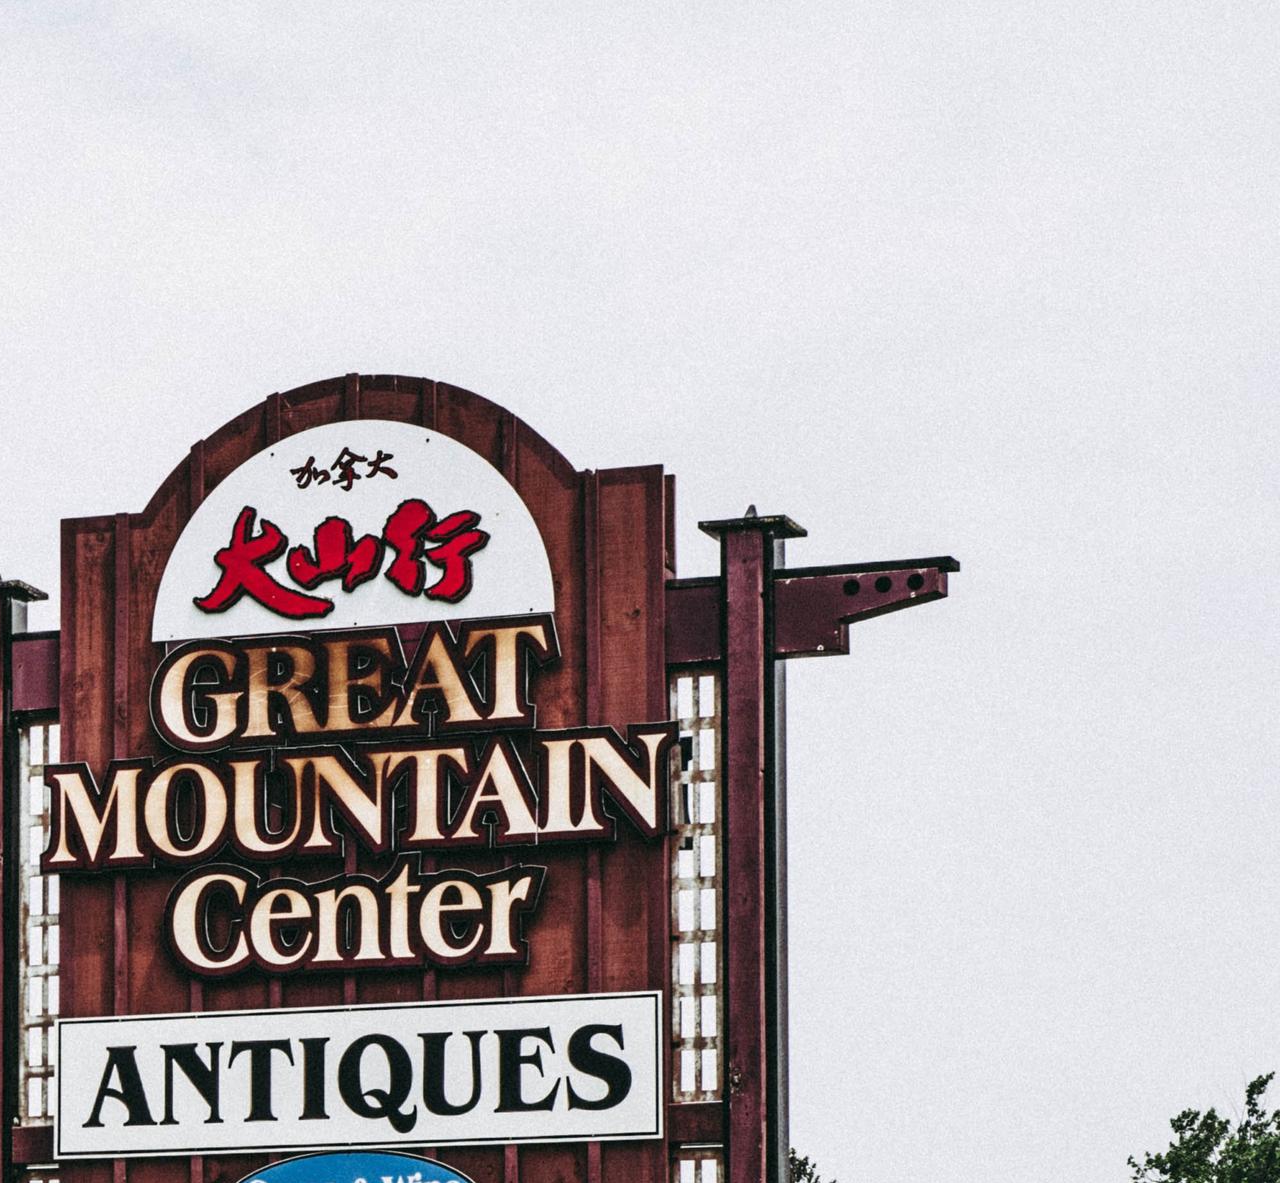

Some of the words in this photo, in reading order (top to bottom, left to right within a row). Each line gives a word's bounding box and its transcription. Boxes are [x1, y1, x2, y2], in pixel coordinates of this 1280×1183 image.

[289, 446, 398, 491] 加拿大
[192, 498, 491, 620] 大山行
[160, 626, 548, 744] GREAT
[48, 732, 670, 864] MOUNTAIN
[171, 864, 533, 970] Center
[82, 1023, 634, 1134] ANTIQUES
